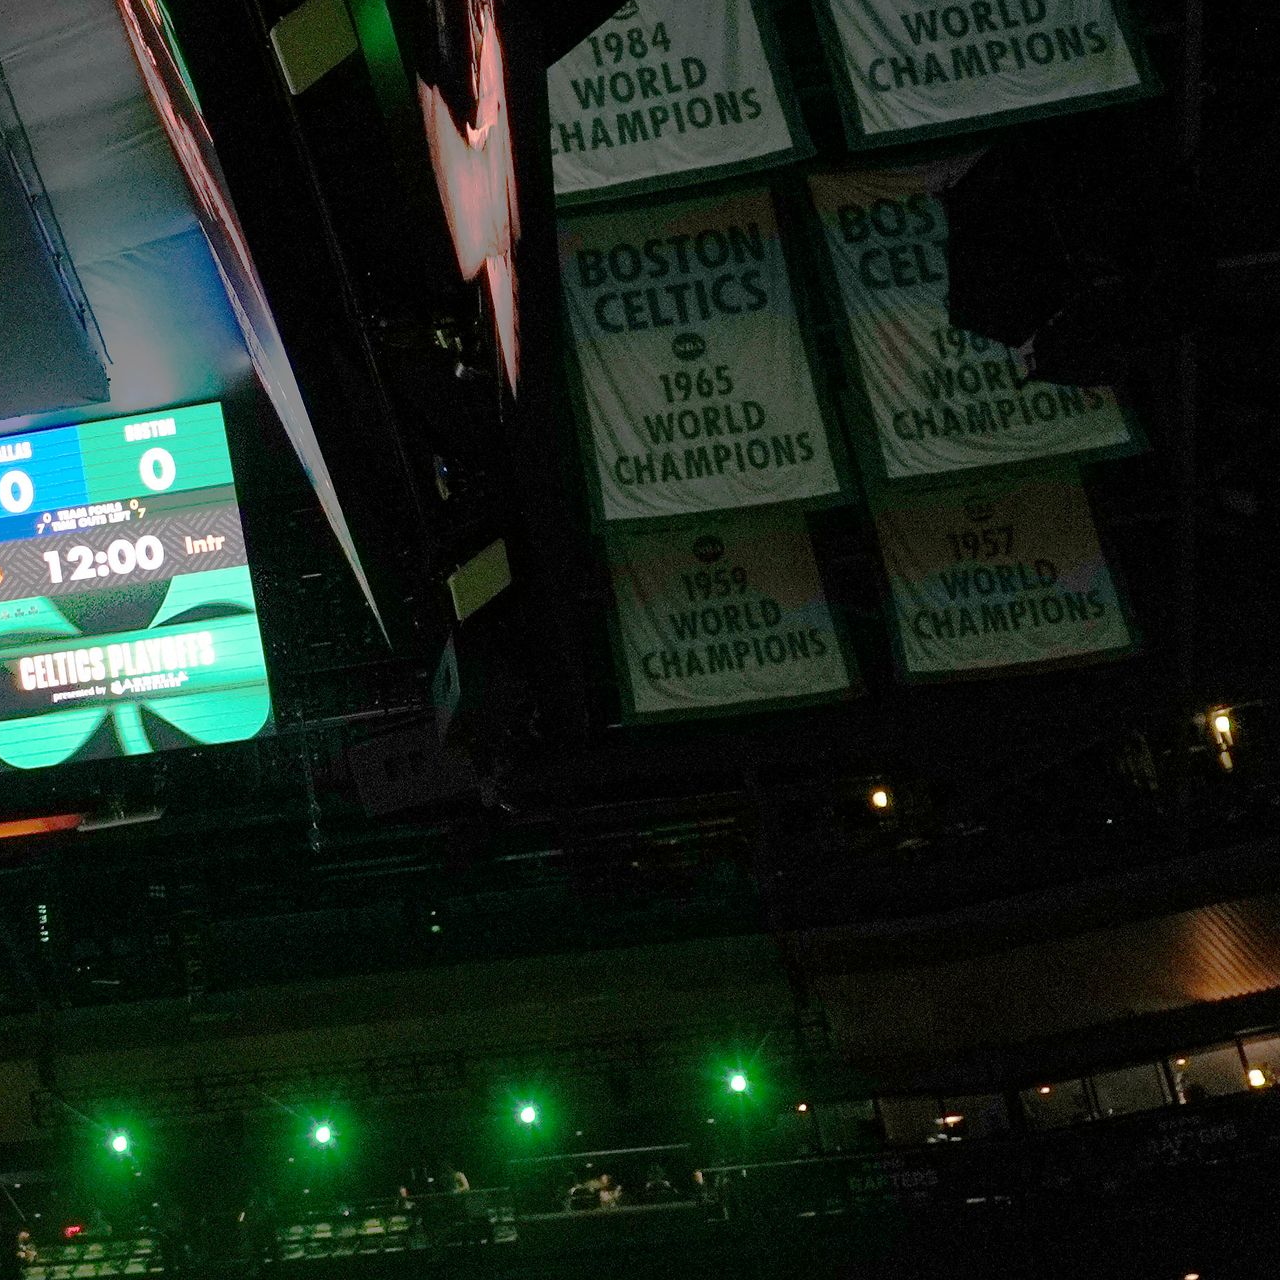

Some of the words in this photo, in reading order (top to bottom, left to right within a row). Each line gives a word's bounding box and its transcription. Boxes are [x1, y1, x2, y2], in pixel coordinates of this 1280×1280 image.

[587, 21, 671, 68] 1984
[867, 21, 1108, 93] CHAMPIONS
[571, 56, 708, 110] WORLD
[550, 87, 763, 156] HAMPIONS
[836, 192, 937, 243] BOS
[576, 222, 766, 289] BOSTON
[593, 268, 769, 334] CELTICS
[659, 364, 734, 404] 1965
[922, 354, 1030, 401] WORL
[643, 400, 766, 446] WORLD
[891, 386, 1106, 441] CHAMPIONS
[139, 447, 177, 492] 0
[613, 431, 815, 487] CHAMPIONS
[43, 534, 165, 584] 12:00
[946, 525, 1015, 561] 1957
[681, 567, 747, 602] 1959
[939, 558, 1059, 601] WORLD
[669, 599, 781, 642] WORLD
[912, 589, 1106, 641] CHAMPIONS
[18, 646, 107, 692] CELTICS
[108, 631, 217, 679] PLAYOFFS
[641, 628, 827, 681] CHAMPIONS
